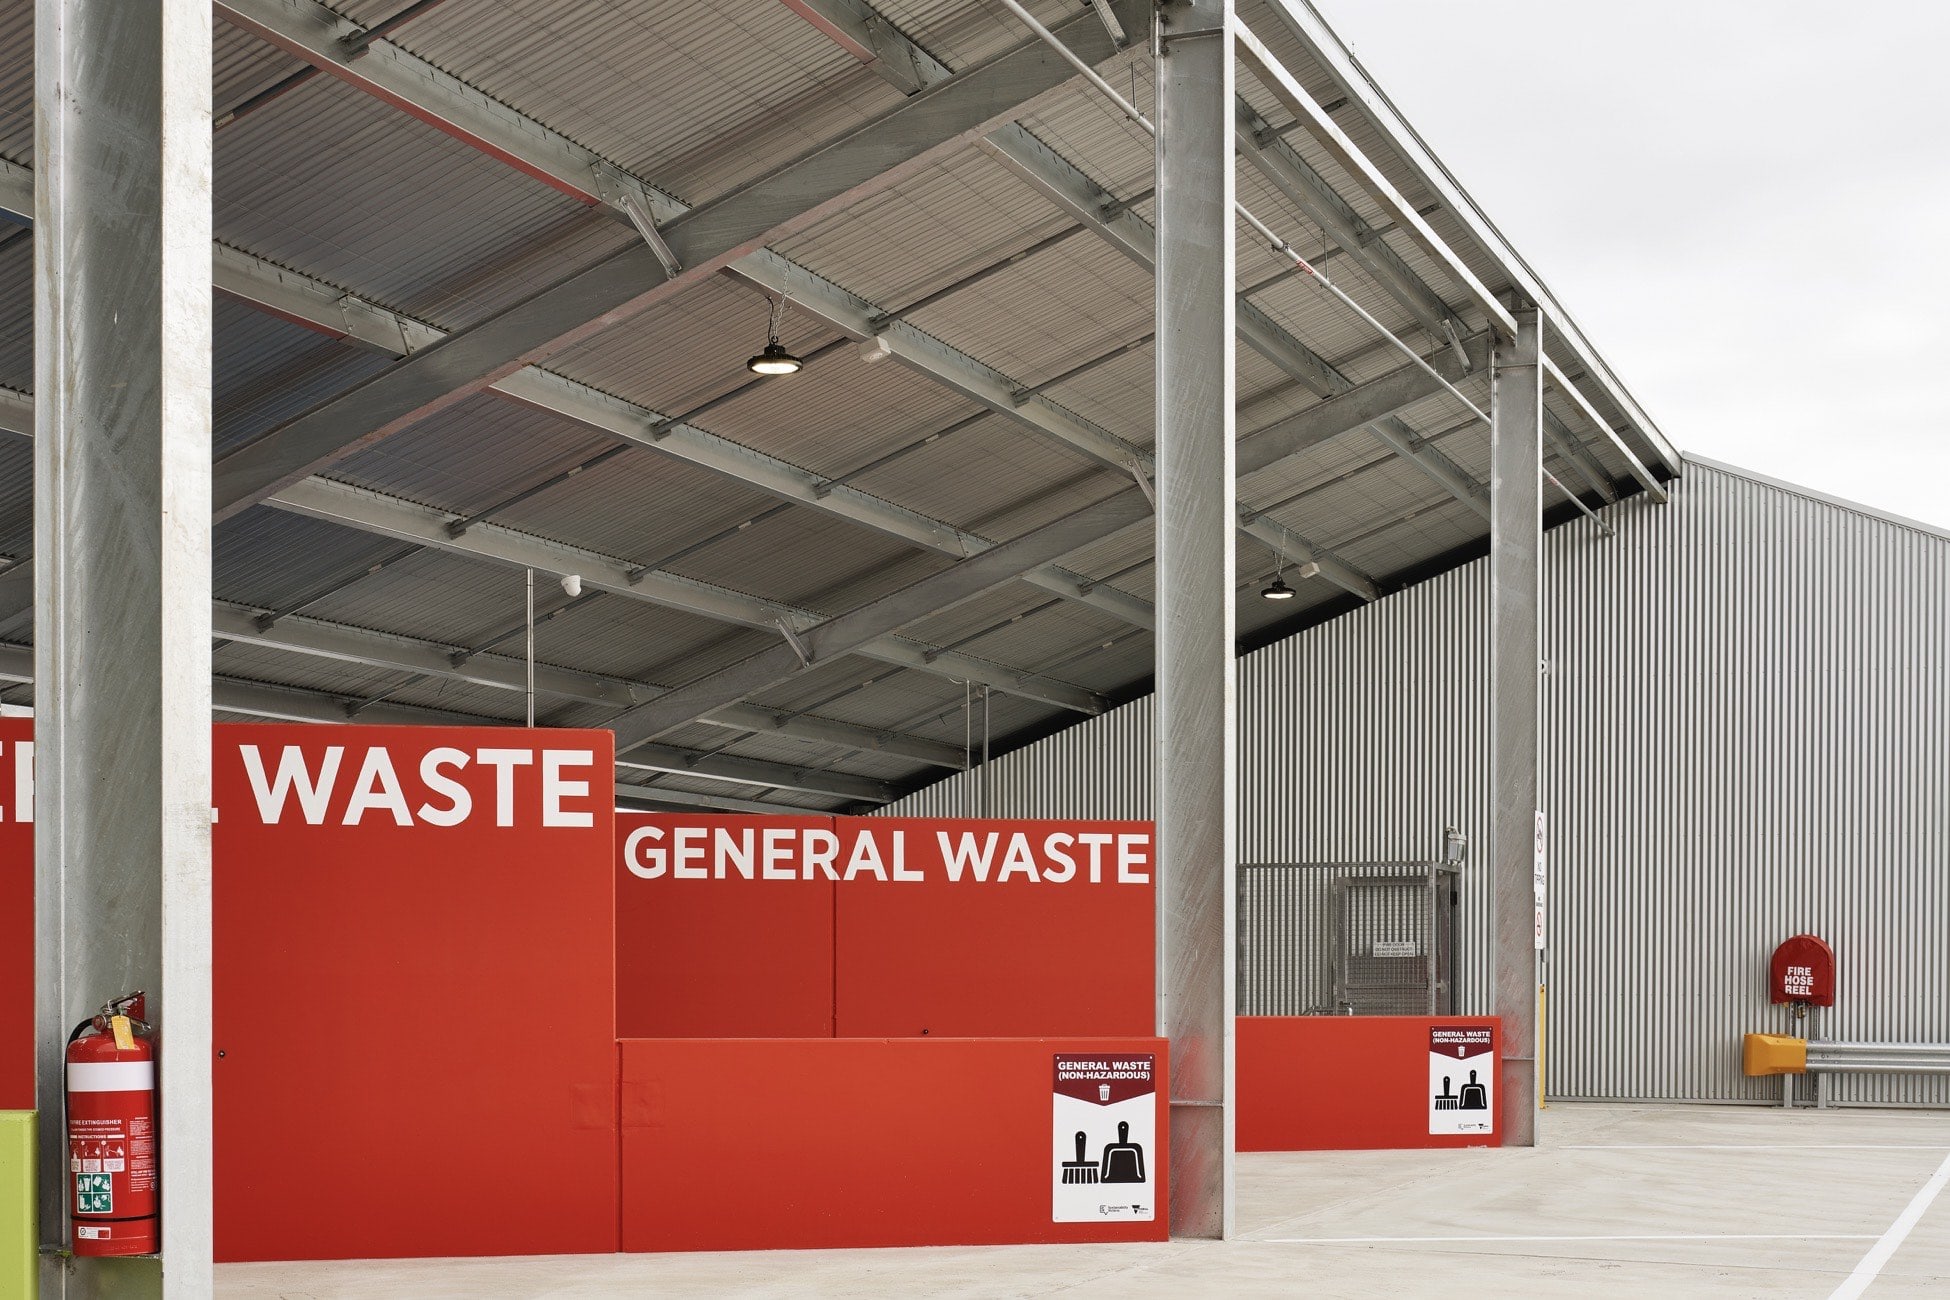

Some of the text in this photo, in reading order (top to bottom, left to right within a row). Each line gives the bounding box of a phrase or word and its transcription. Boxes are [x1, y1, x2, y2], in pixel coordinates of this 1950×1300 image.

[239, 745, 593, 827] WASTE
[625, 826, 1149, 883] GENERAL WASTE
[1787, 966, 1812, 976] FIRE
[1784, 975, 1814, 986] HOSE
[1785, 985, 1812, 995] REEL
[1058, 1061, 1151, 1070] GENERAL WASTE
[1058, 1071, 1150, 1081] (NON-HAZARDOUS)
